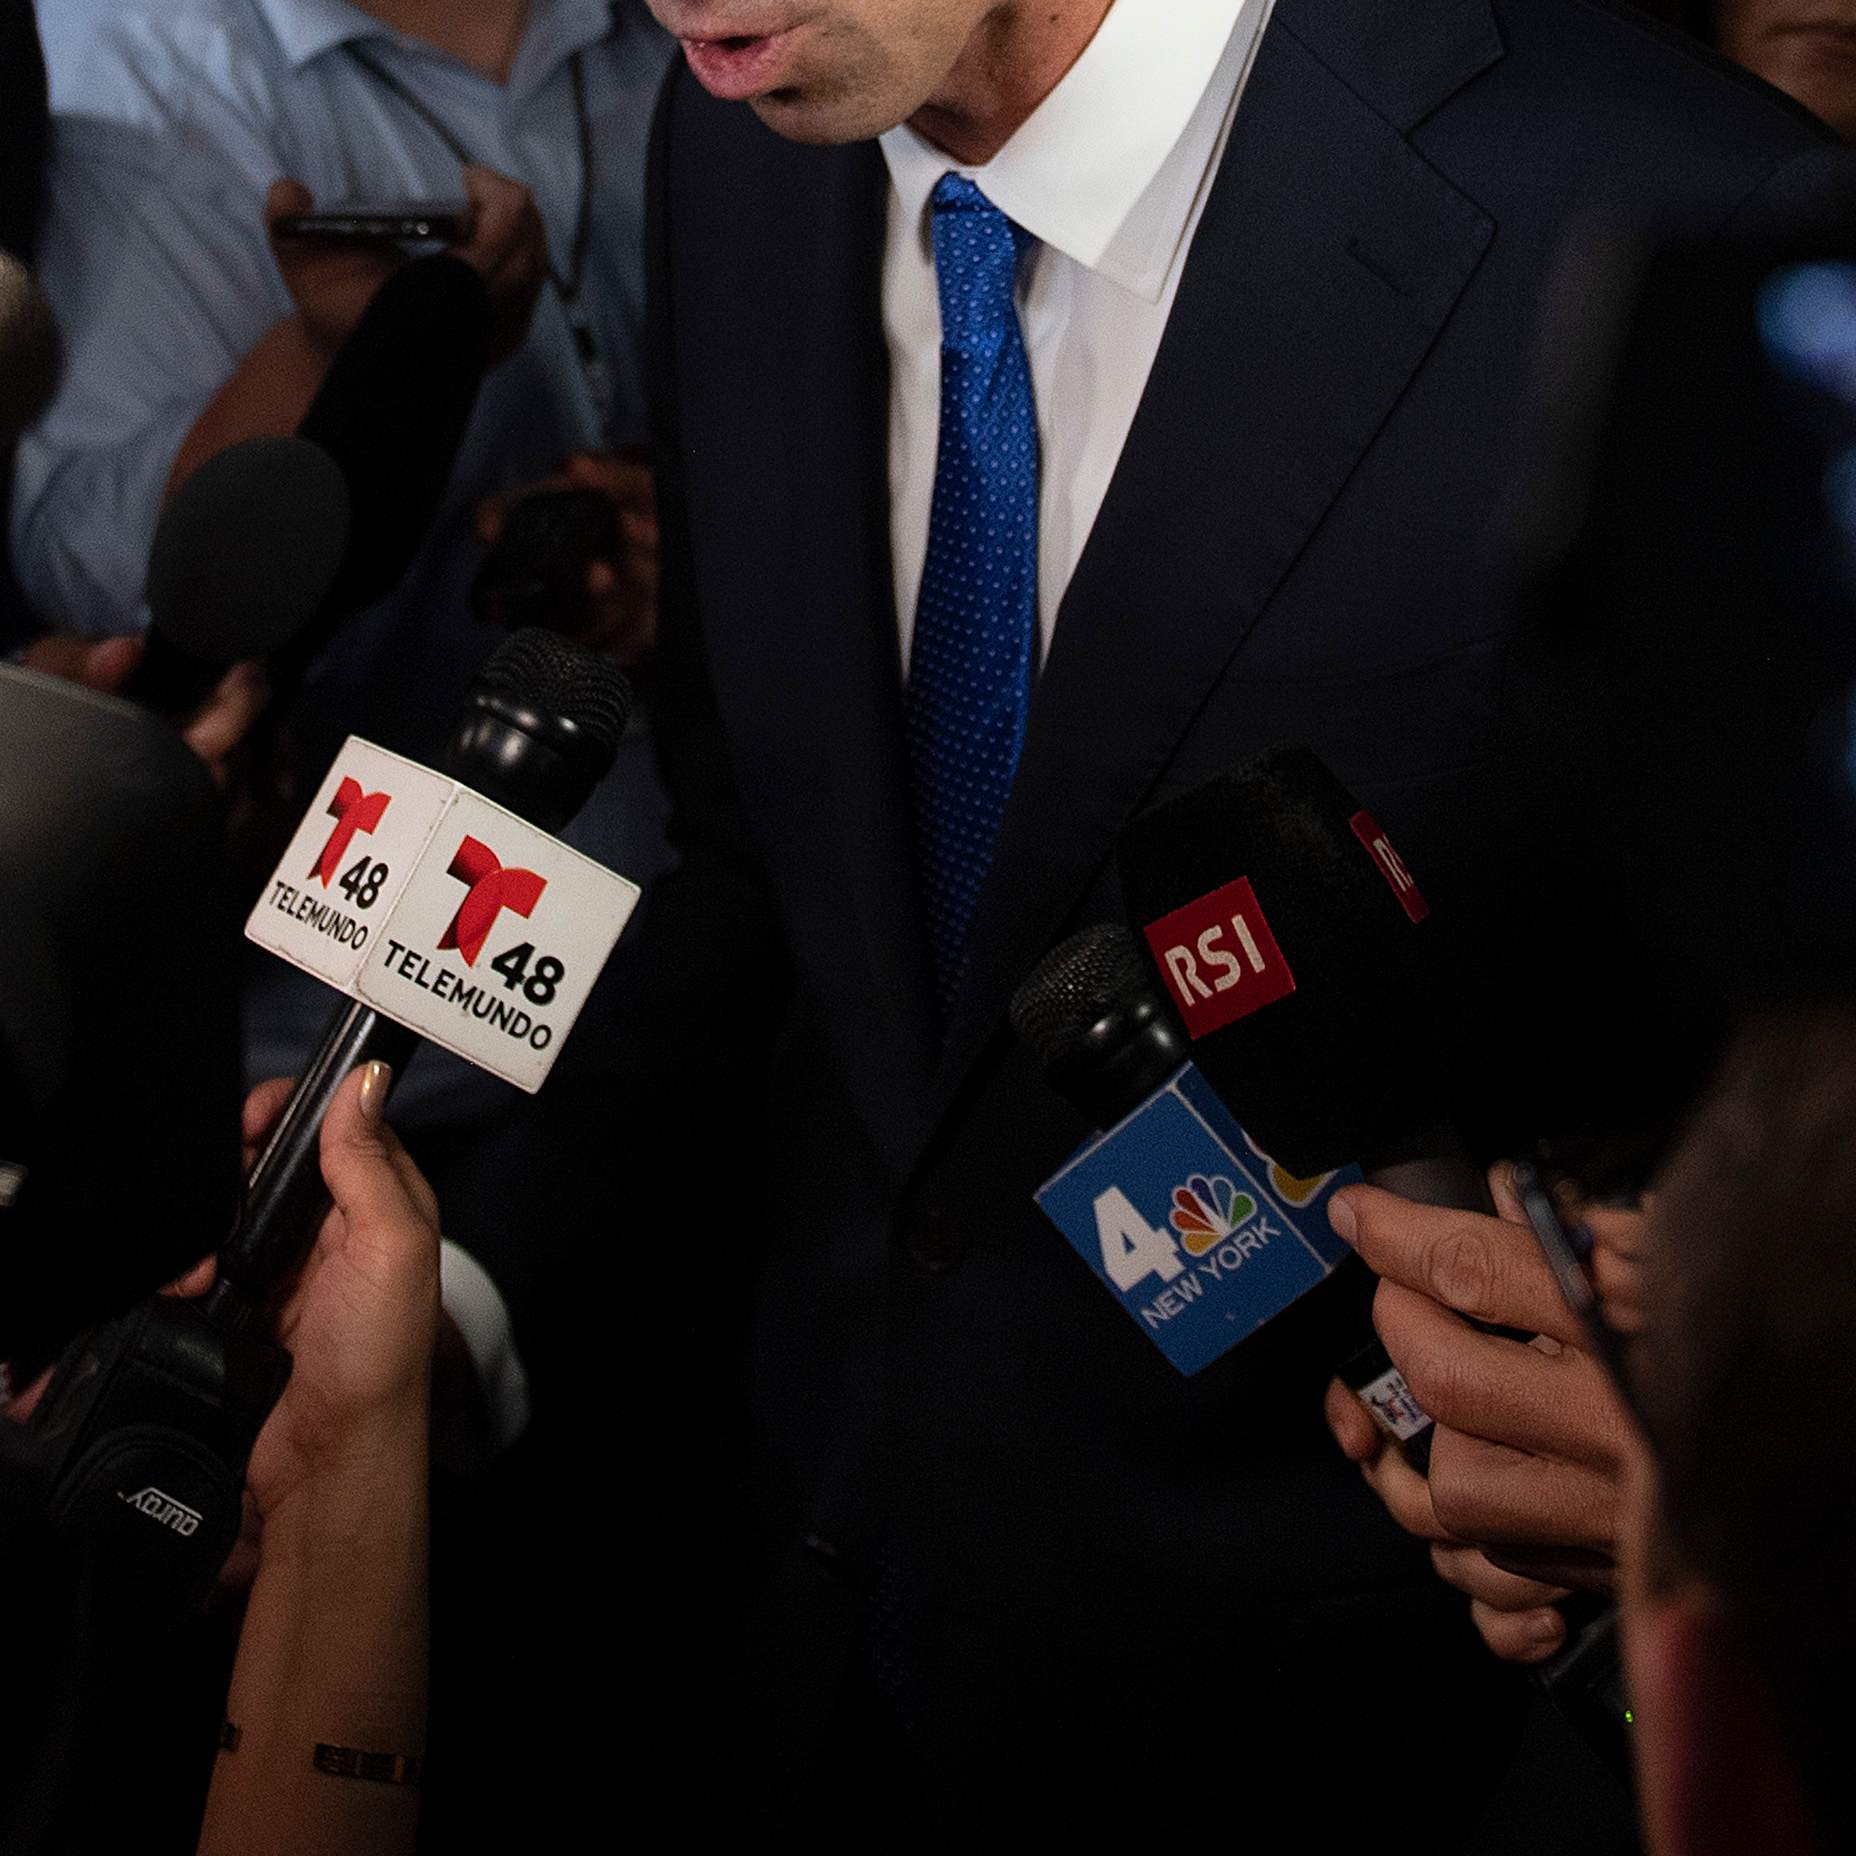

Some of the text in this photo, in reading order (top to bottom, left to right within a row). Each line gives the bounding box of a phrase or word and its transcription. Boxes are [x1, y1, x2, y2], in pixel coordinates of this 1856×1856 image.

[268, 881, 368, 950] TELEMUNDO
[338, 856, 389, 909] 48
[383, 940, 552, 1050] TELEMUNDO
[491, 942, 565, 1005] 48
[1164, 913, 1267, 1007] RSI
[1093, 1185, 1185, 1293] 4
[1140, 1216, 1283, 1330] NEW YORK
[125, 1485, 205, 1538] auray
